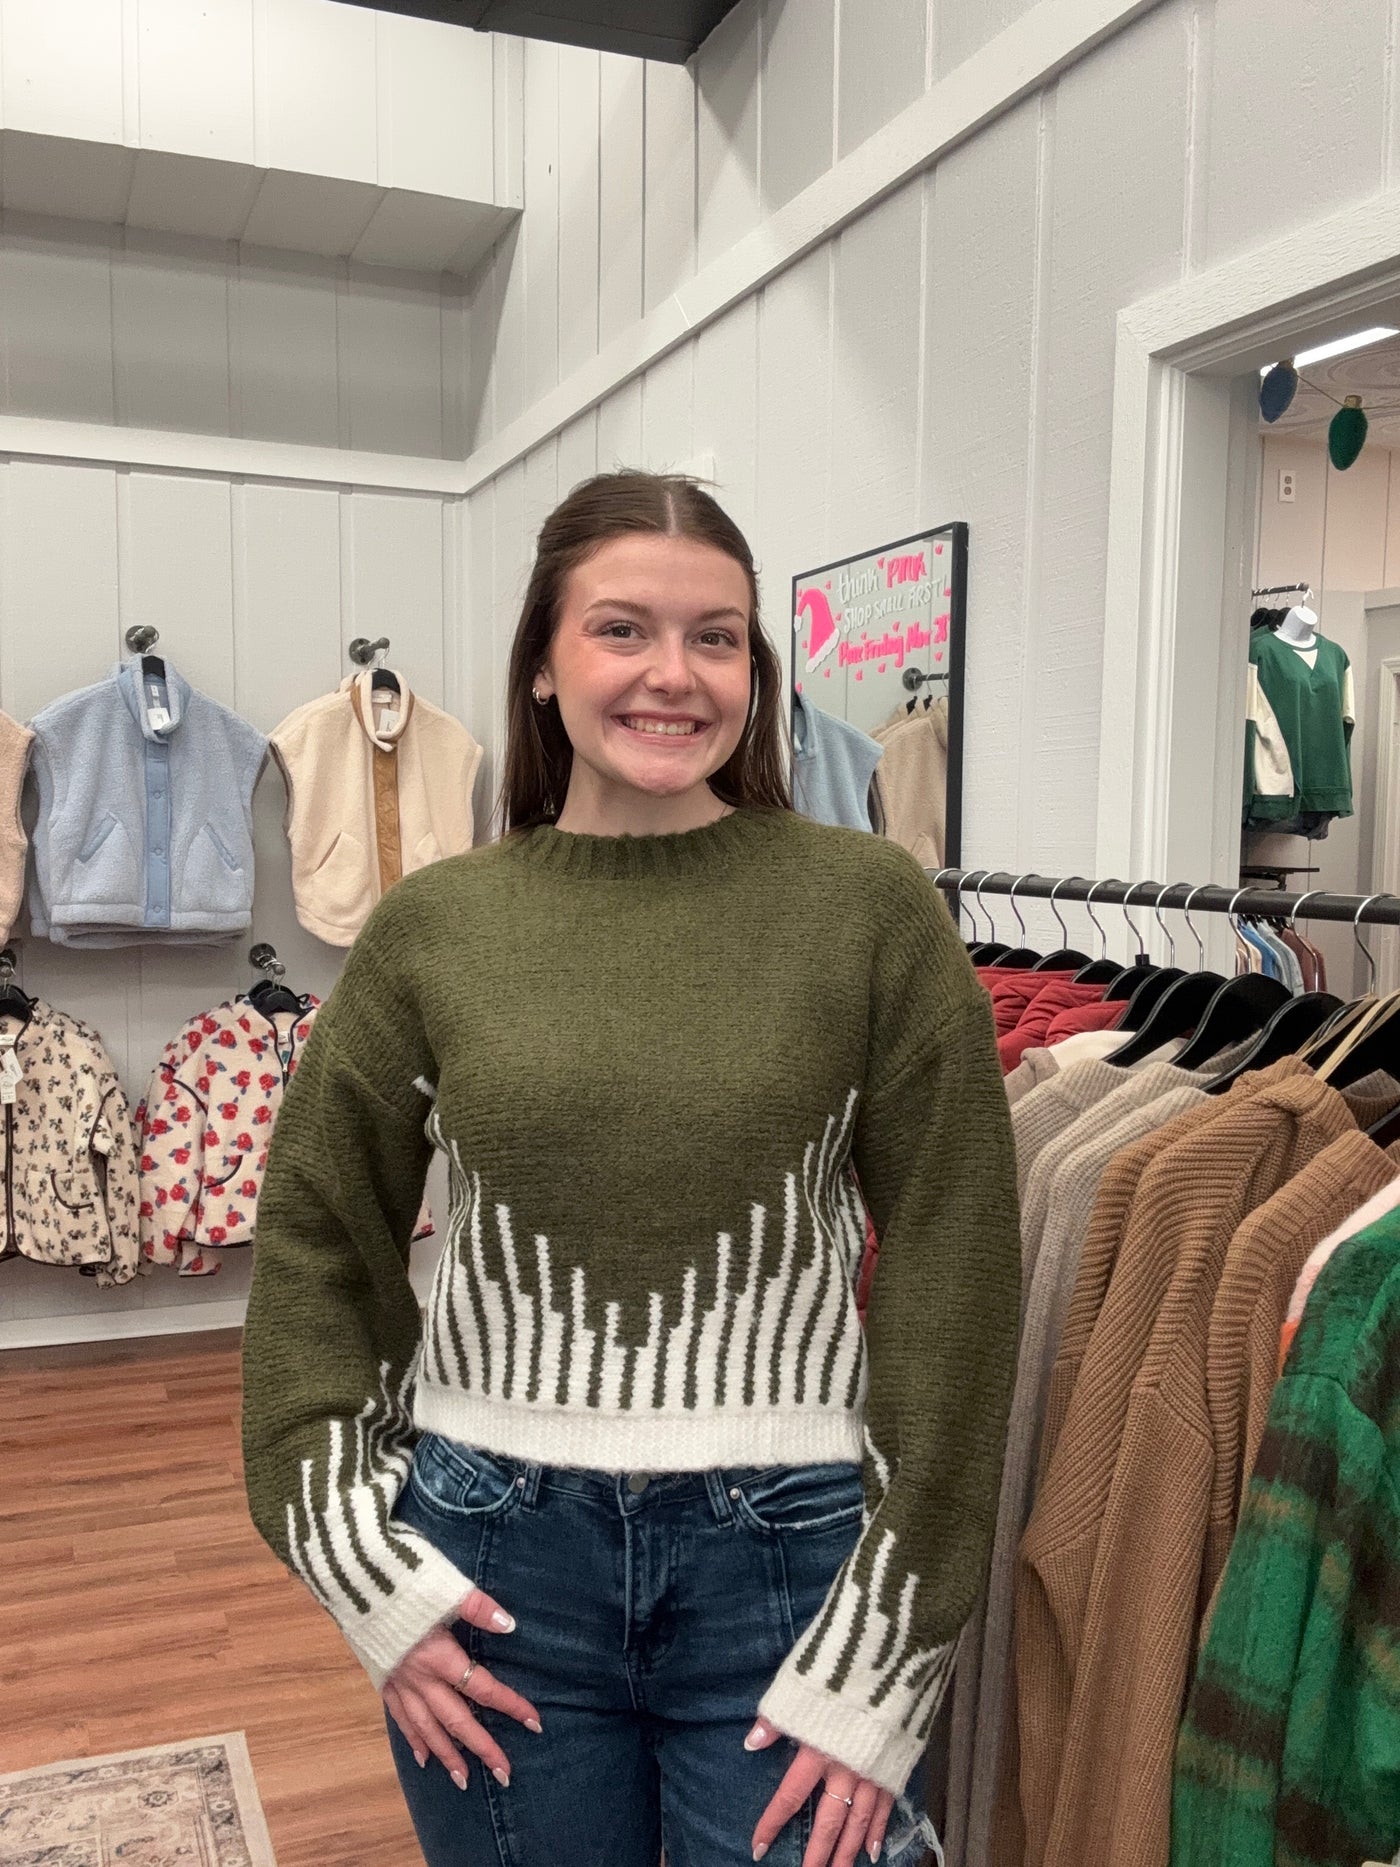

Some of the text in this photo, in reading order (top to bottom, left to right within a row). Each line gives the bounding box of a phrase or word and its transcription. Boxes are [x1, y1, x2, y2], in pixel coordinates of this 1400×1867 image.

[886, 551, 927, 589] PINK
[843, 603, 873, 634] SHOP
[874, 593, 904, 620] SMALL
